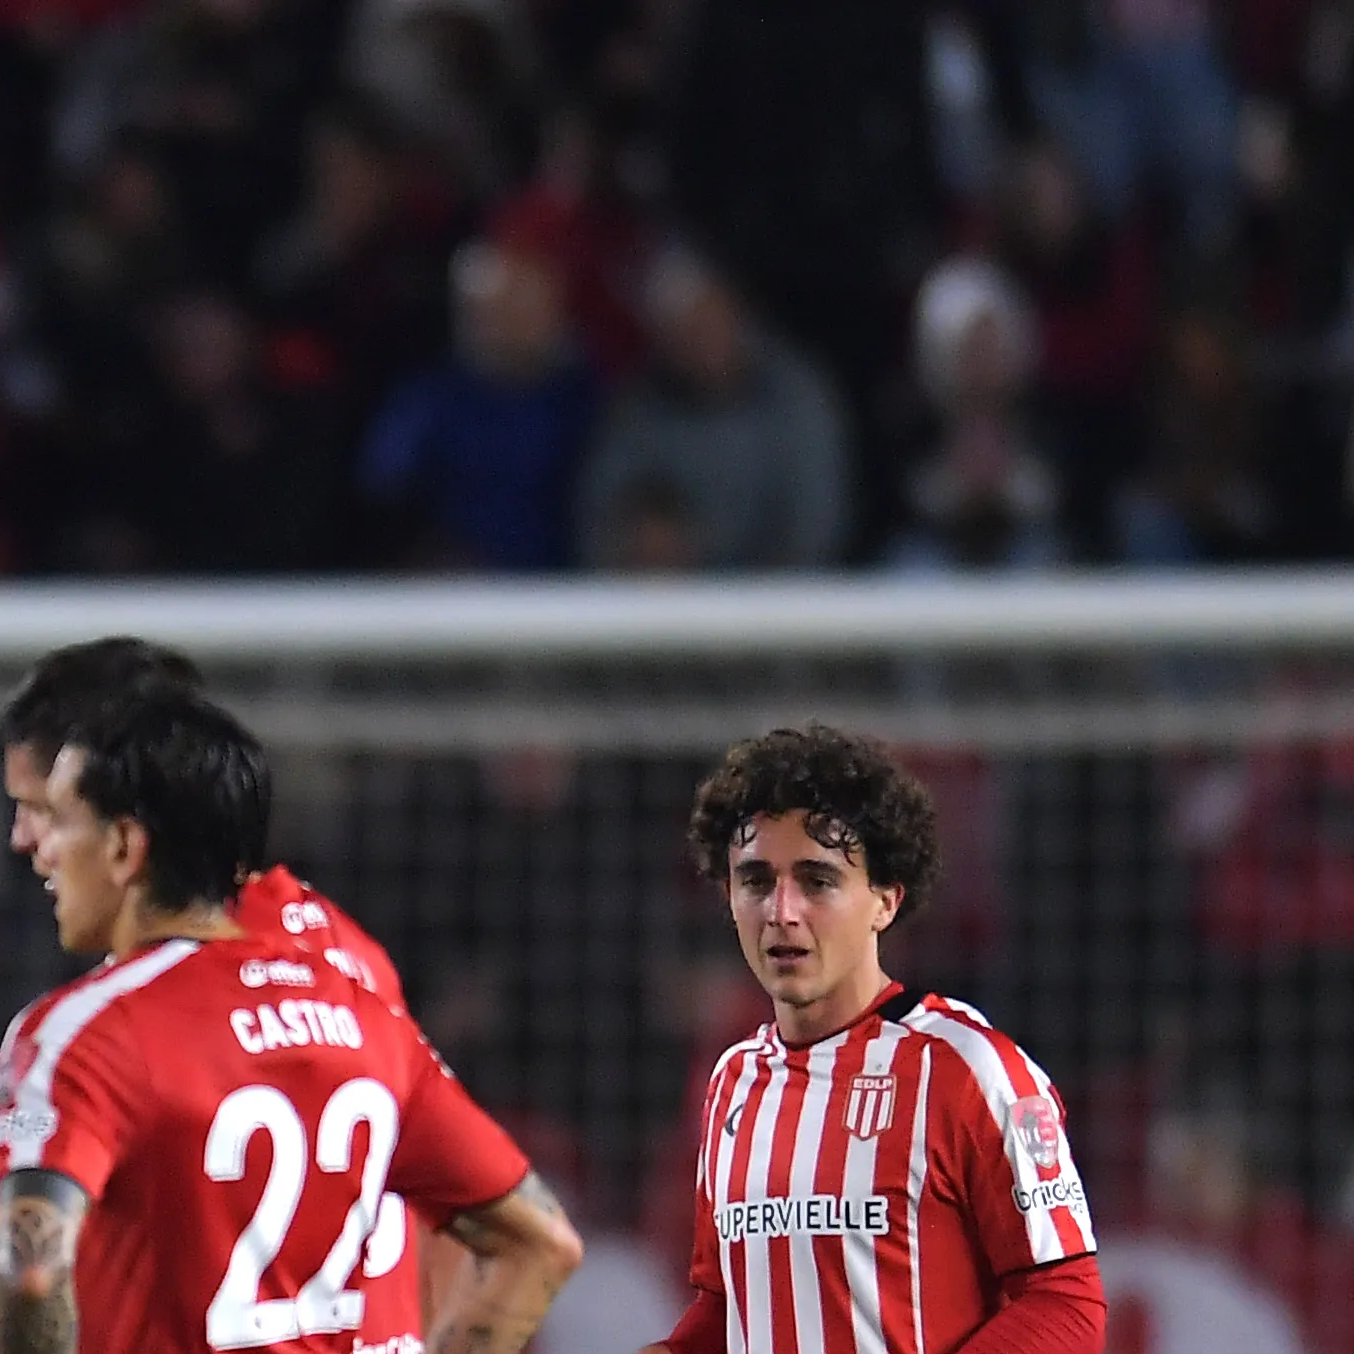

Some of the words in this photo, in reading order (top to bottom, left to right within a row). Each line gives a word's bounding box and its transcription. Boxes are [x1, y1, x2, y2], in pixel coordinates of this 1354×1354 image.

[230, 998, 364, 1055] CASTRO
[204, 1077, 400, 1351] 22
[714, 1200, 883, 1240] UPERVIELLE
